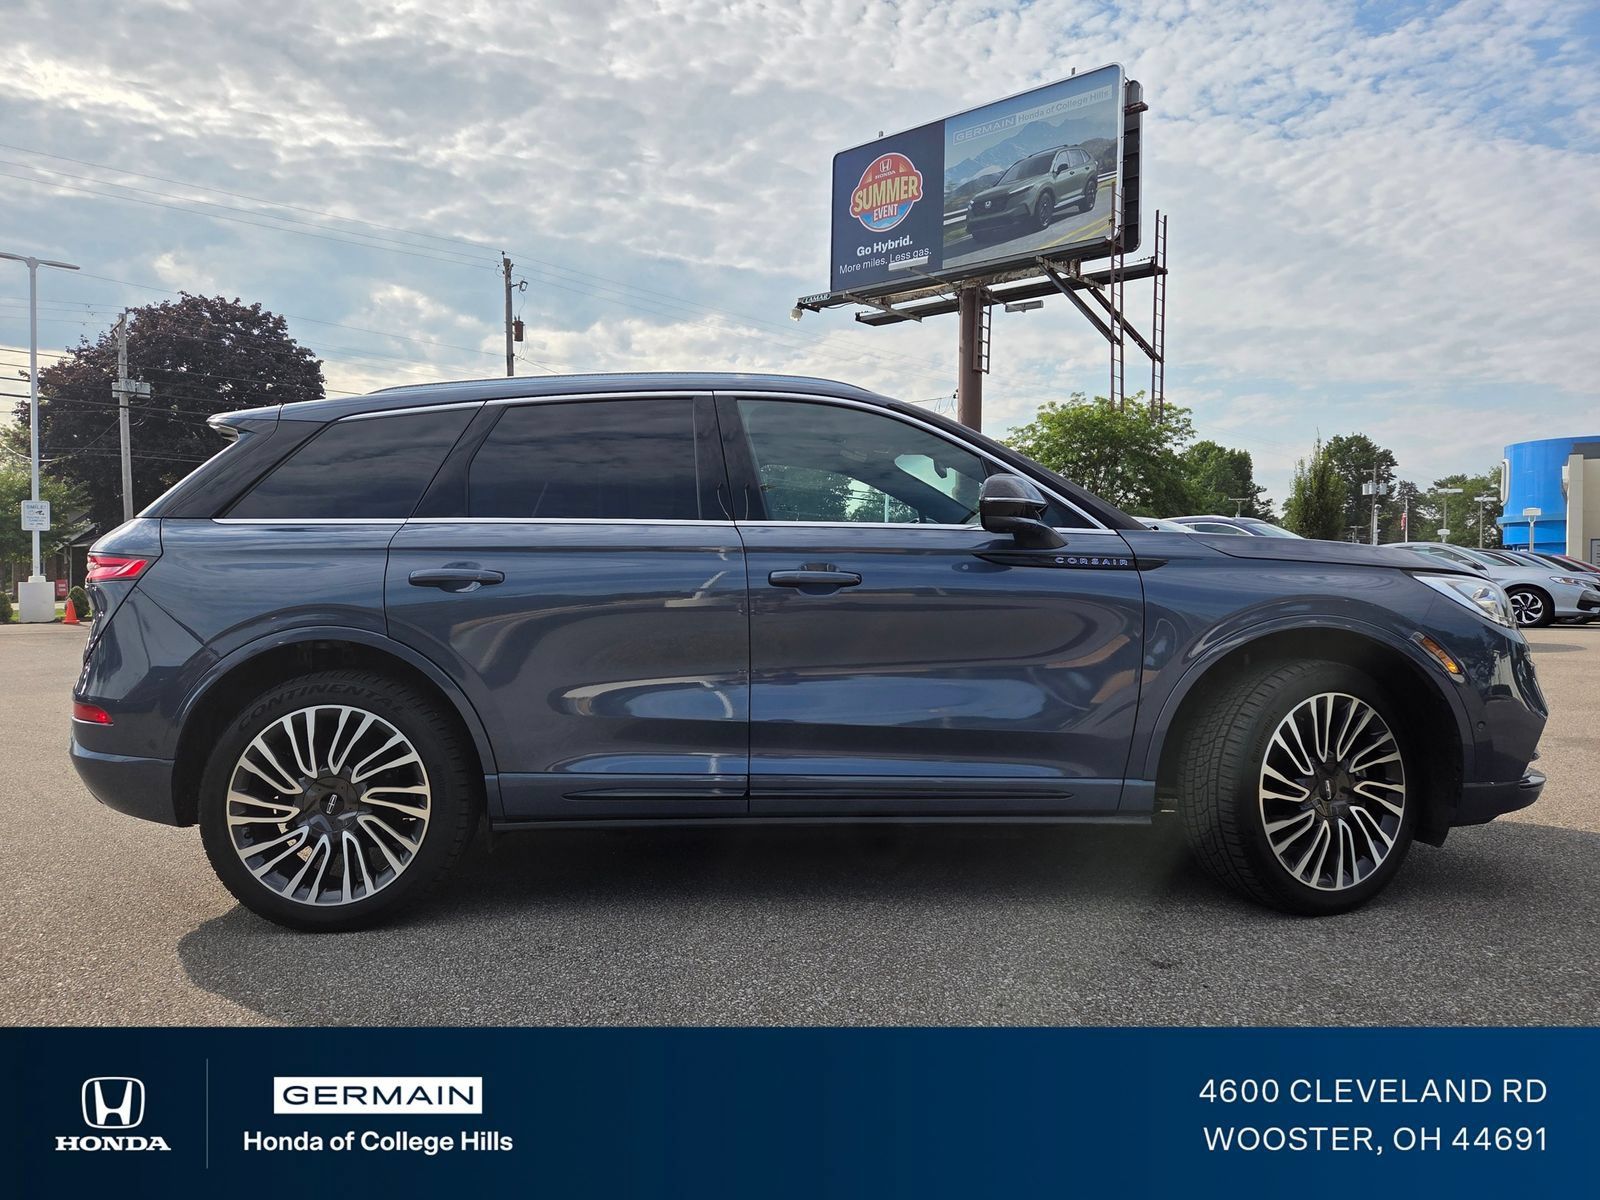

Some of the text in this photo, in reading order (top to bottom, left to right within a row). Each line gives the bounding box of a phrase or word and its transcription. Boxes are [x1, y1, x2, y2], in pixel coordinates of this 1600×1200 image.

[955, 117, 1016, 141] GERMAIN
[1018, 110, 1044, 123] Honda
[1046, 105, 1055, 115] of
[1056, 96, 1088, 111] College
[875, 170, 896, 180] HONDA
[853, 175, 919, 213] SUMMER
[873, 203, 898, 221] EVENT
[856, 235, 913, 257] Go Hybrid.
[839, 247, 932, 274] More miles. Less gas.
[1055, 557, 1128, 566] CORSAIR
